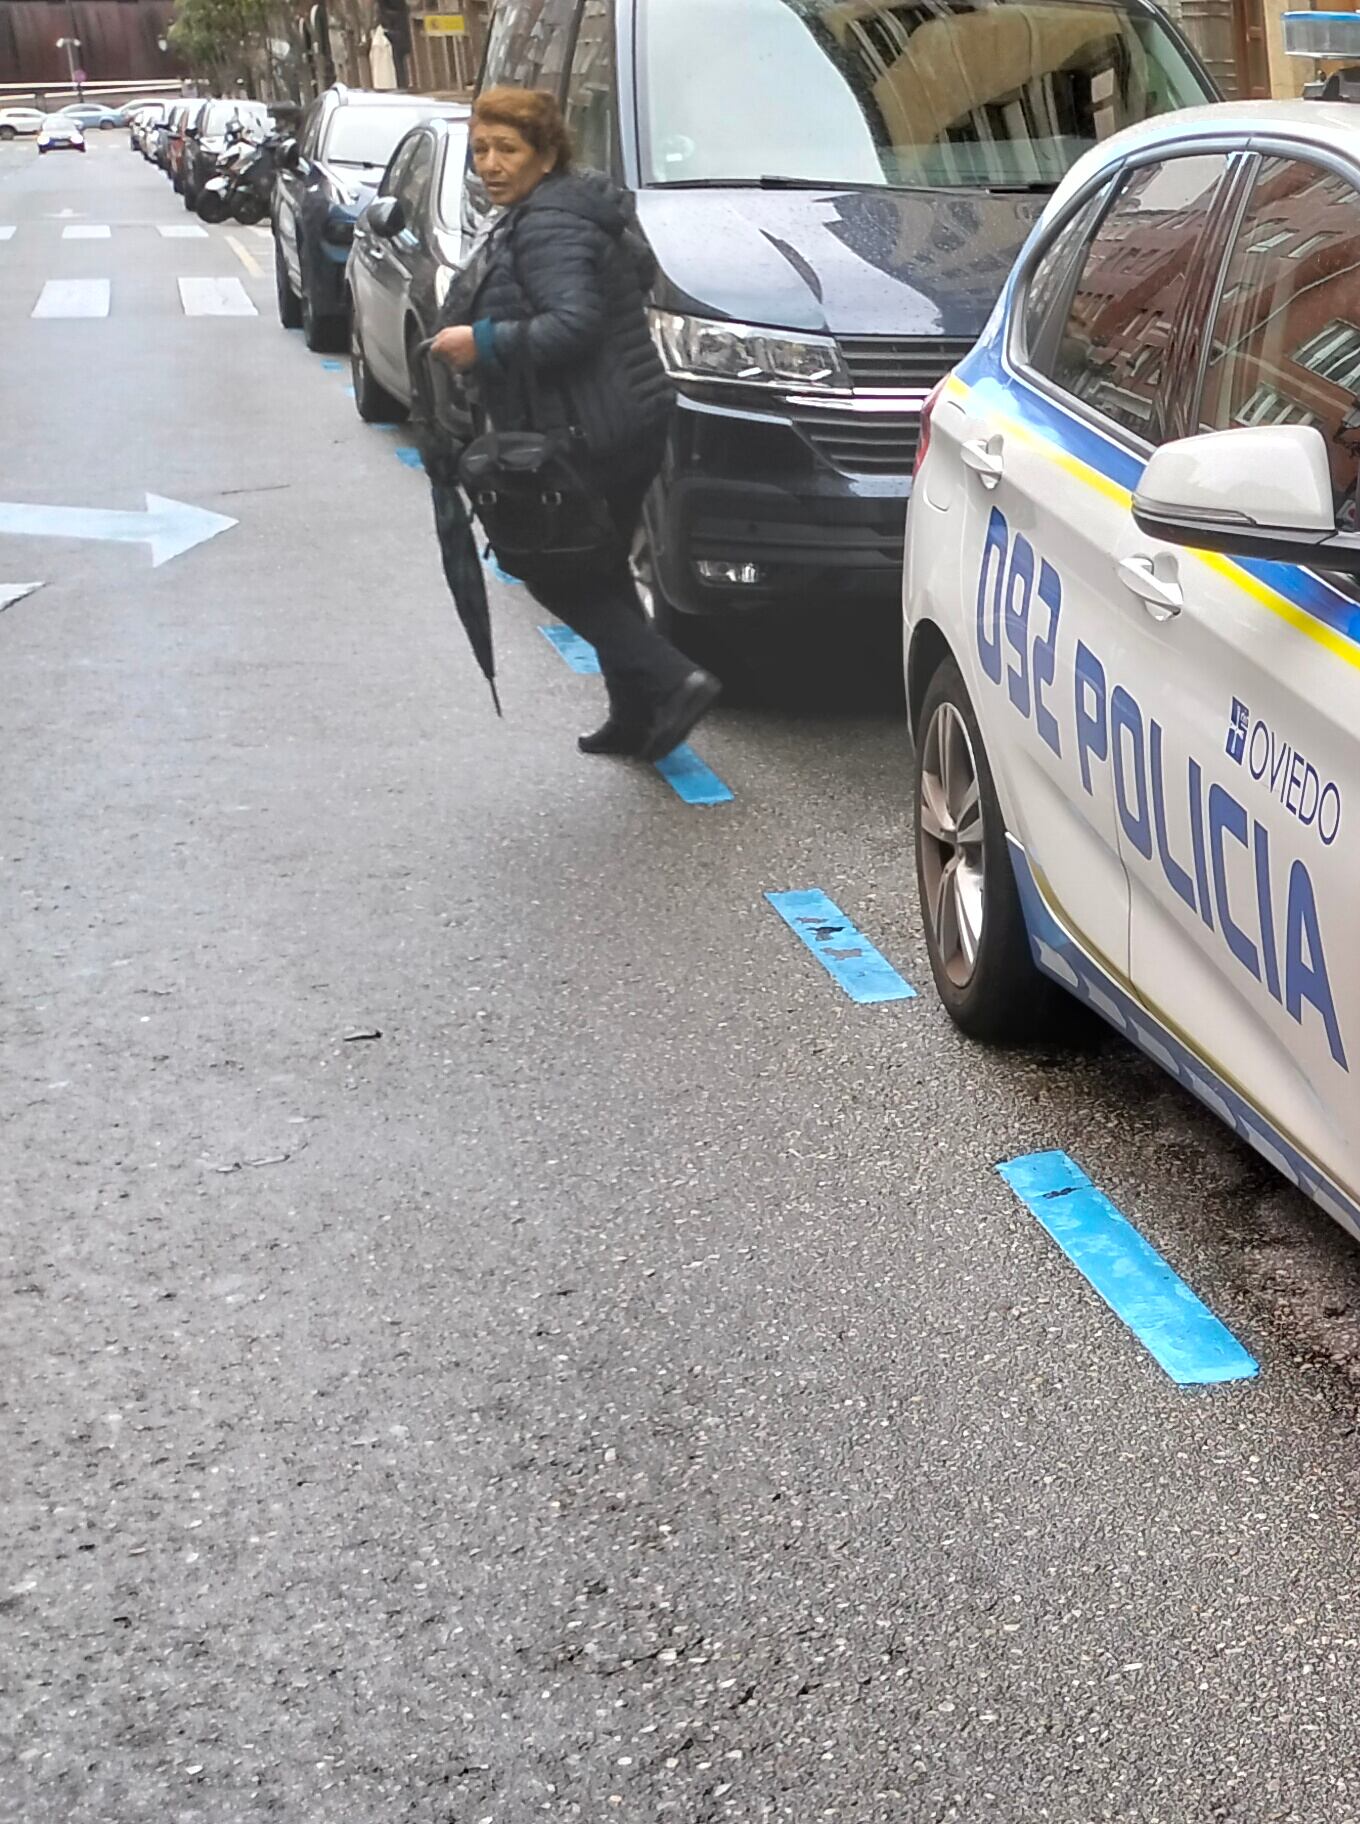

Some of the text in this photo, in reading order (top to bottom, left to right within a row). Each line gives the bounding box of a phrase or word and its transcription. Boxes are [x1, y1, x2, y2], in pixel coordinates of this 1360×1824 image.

[977, 505, 1350, 1073] 092 POLICIA
[1249, 720, 1341, 845] OVIEDO
